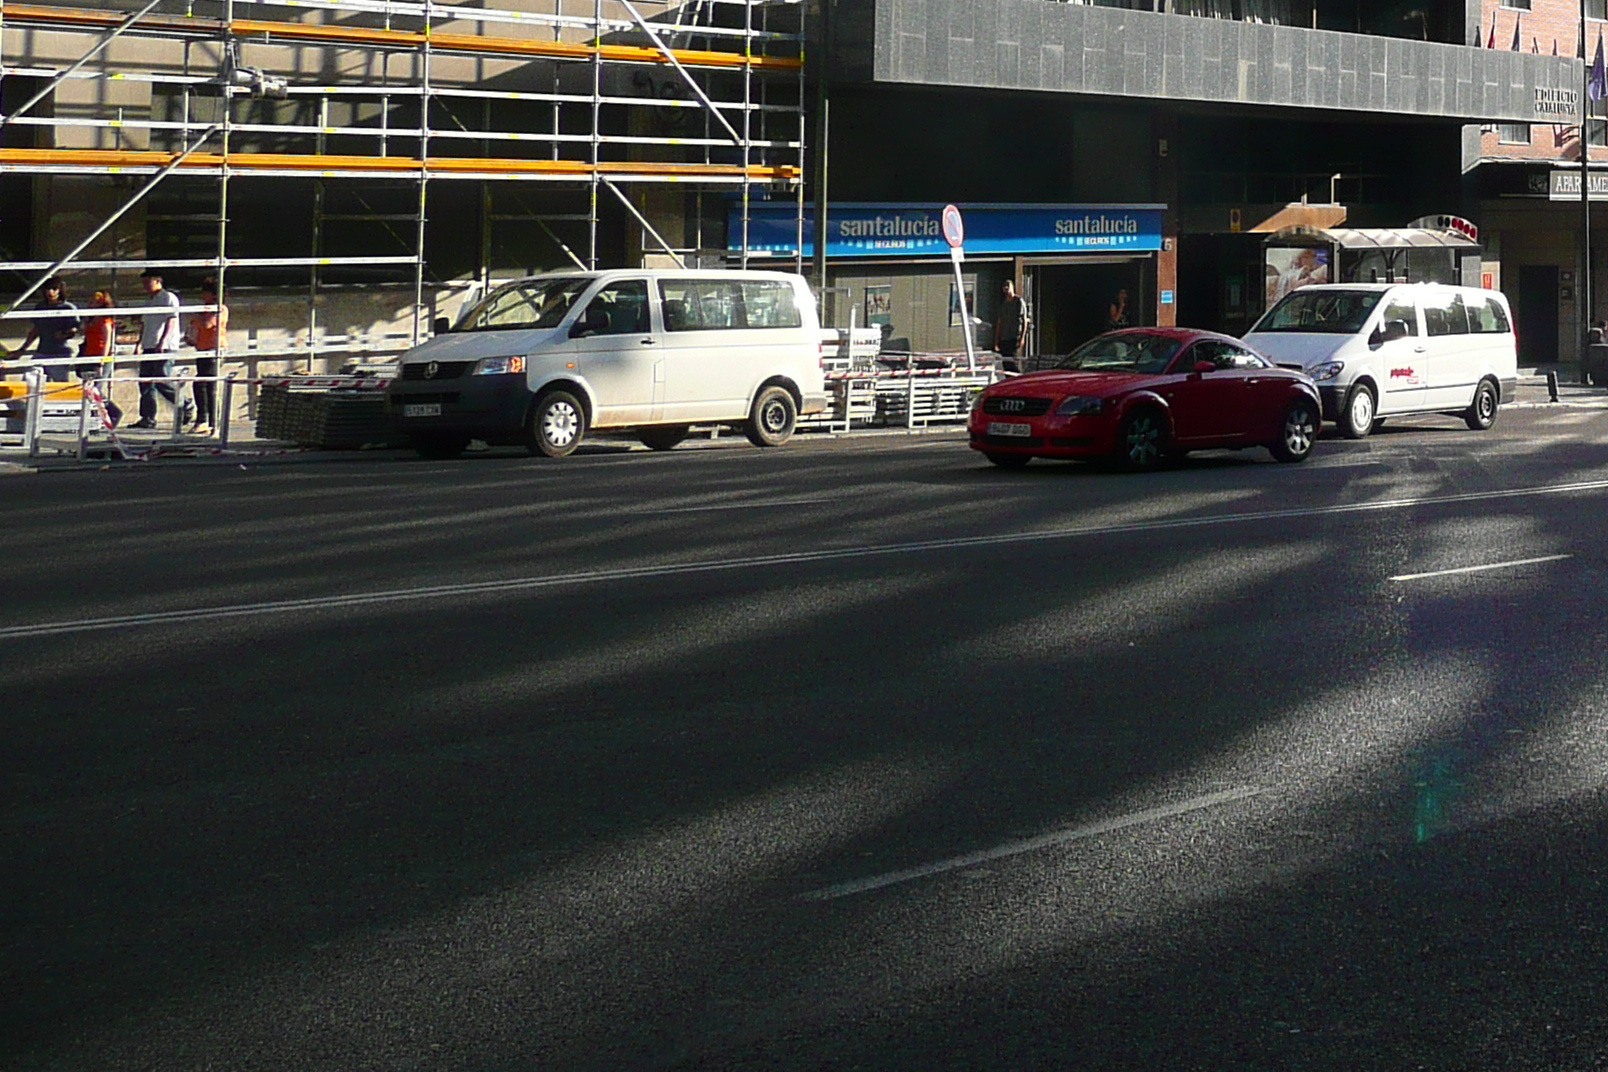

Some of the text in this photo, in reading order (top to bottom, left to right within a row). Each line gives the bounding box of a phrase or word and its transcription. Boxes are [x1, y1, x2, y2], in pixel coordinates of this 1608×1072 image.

[1535, 88, 1578, 104] EDIFICIO
[839, 215, 939, 237] santalucía
[1054, 214, 1138, 235] santalucía
